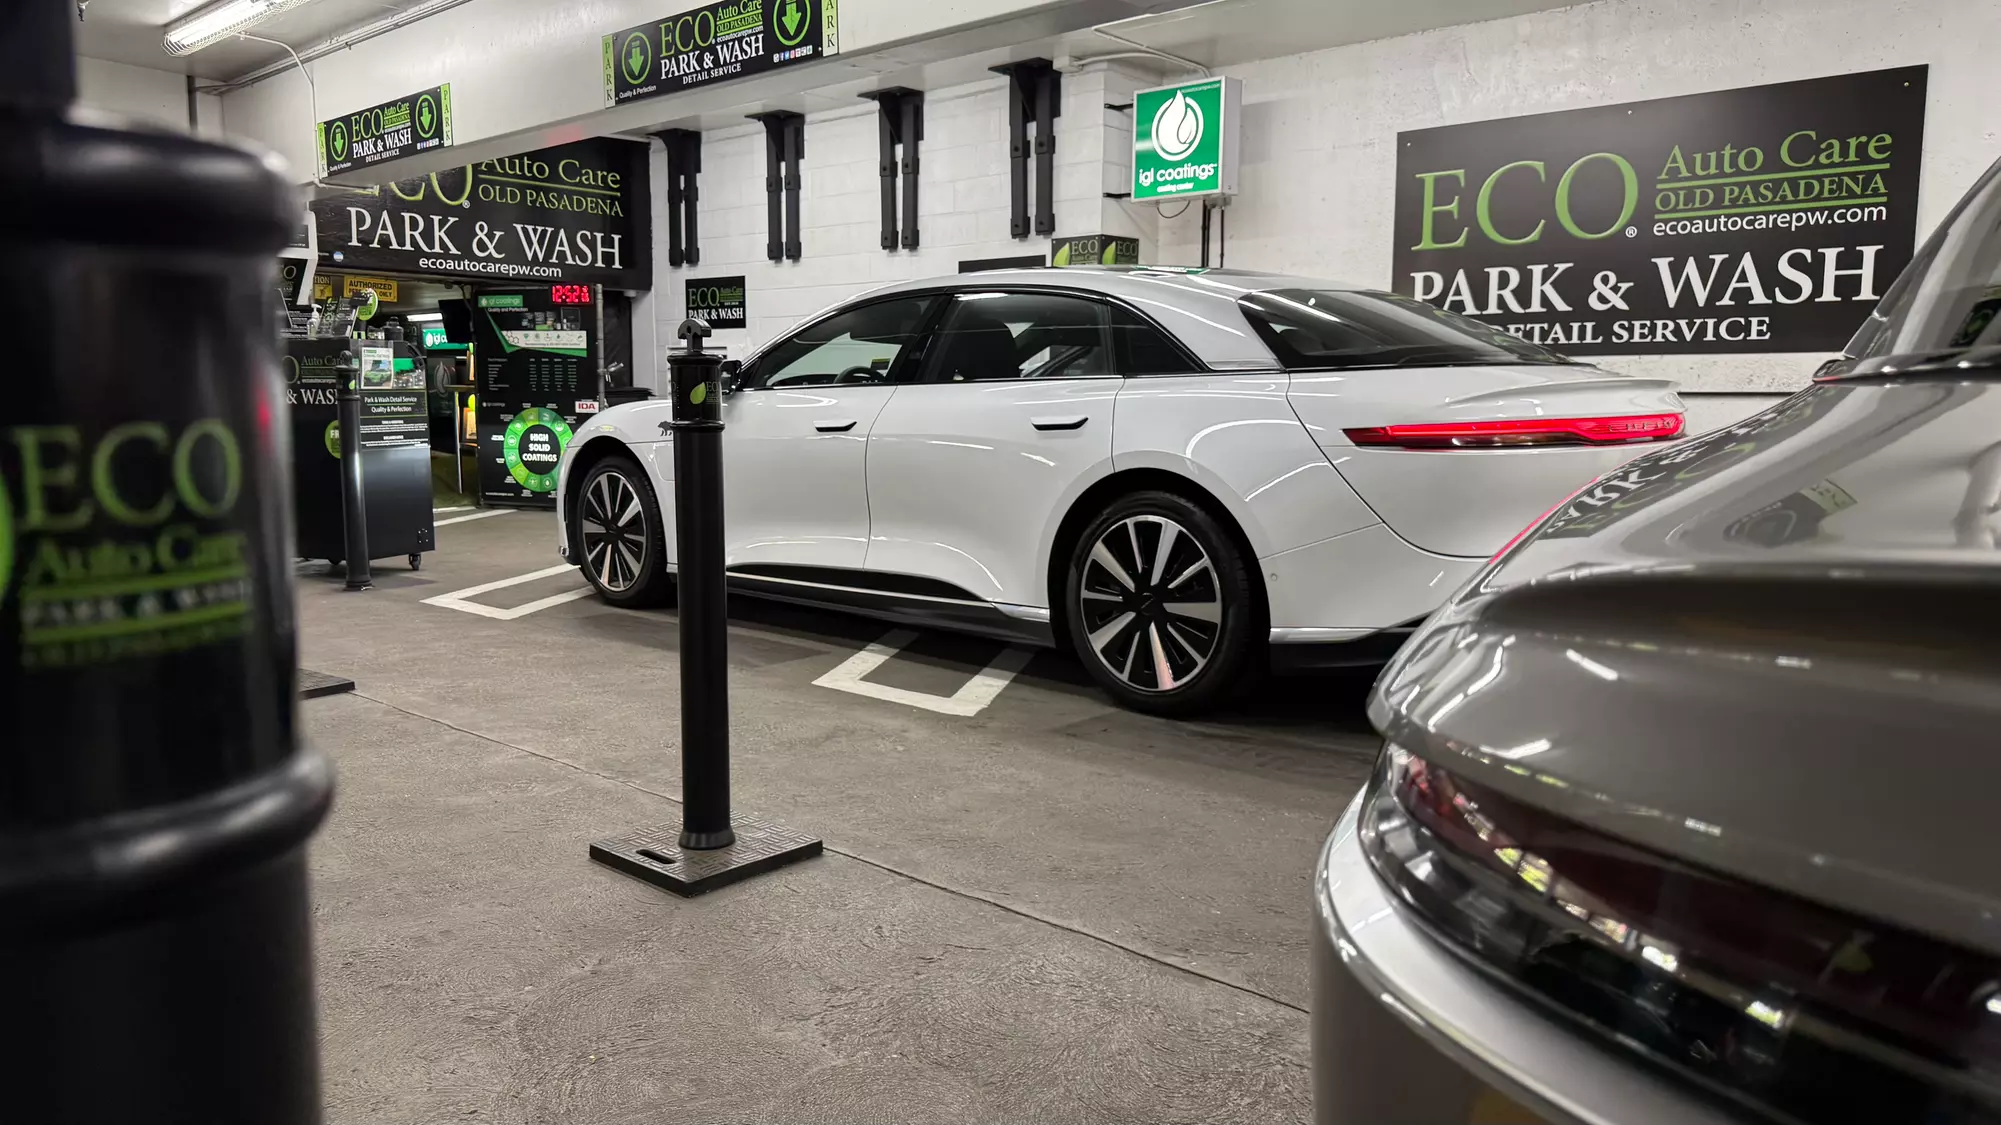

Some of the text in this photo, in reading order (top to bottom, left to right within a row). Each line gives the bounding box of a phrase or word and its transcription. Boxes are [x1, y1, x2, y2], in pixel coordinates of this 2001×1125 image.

[716, 0, 762, 21] Auto Care
[717, 14, 763, 33] OLD PASADENA
[825, 0, 835, 48] ARK
[660, 34, 764, 80] PARK & WASH
[604, 43, 613, 101] PARK
[683, 63, 742, 85] DETAIL SERVICE
[619, 90, 632, 99] Quality
[637, 84, 656, 95] Perfection
[353, 138, 375, 158] PARK
[376, 139, 384, 152] &
[384, 127, 412, 150] WASH
[366, 148, 400, 163] DETAIL SERVICE
[1656, 130, 1893, 180] Auto Care
[558, 158, 621, 189] Care
[1139, 168, 1154, 186] igl
[479, 183, 521, 204] OLD
[526, 187, 624, 217] PASADENA
[1655, 173, 1888, 211] OLD PASADENA
[1653, 205, 1887, 236] ecoautocarepw.com
[347, 206, 623, 269] PARK & WASH
[1071, 239, 1098, 255] ECO
[419, 257, 562, 279] ecoautocarepw.com
[314, 275, 330, 284] TION
[349, 279, 393, 292] AUTHORIZED
[1410, 245, 1884, 316] PARK & WASH
[688, 307, 744, 320] PARK & WASH
[1611, 316, 1771, 343] SERVICE
[301, 355, 322, 366] Auto
[286, 388, 338, 405] & WAS
[528, 443, 551, 452] SOLID
[530, 433, 549, 442] HIGH
[522, 453, 558, 462] COATINGS
[11, 418, 242, 531] ECO
